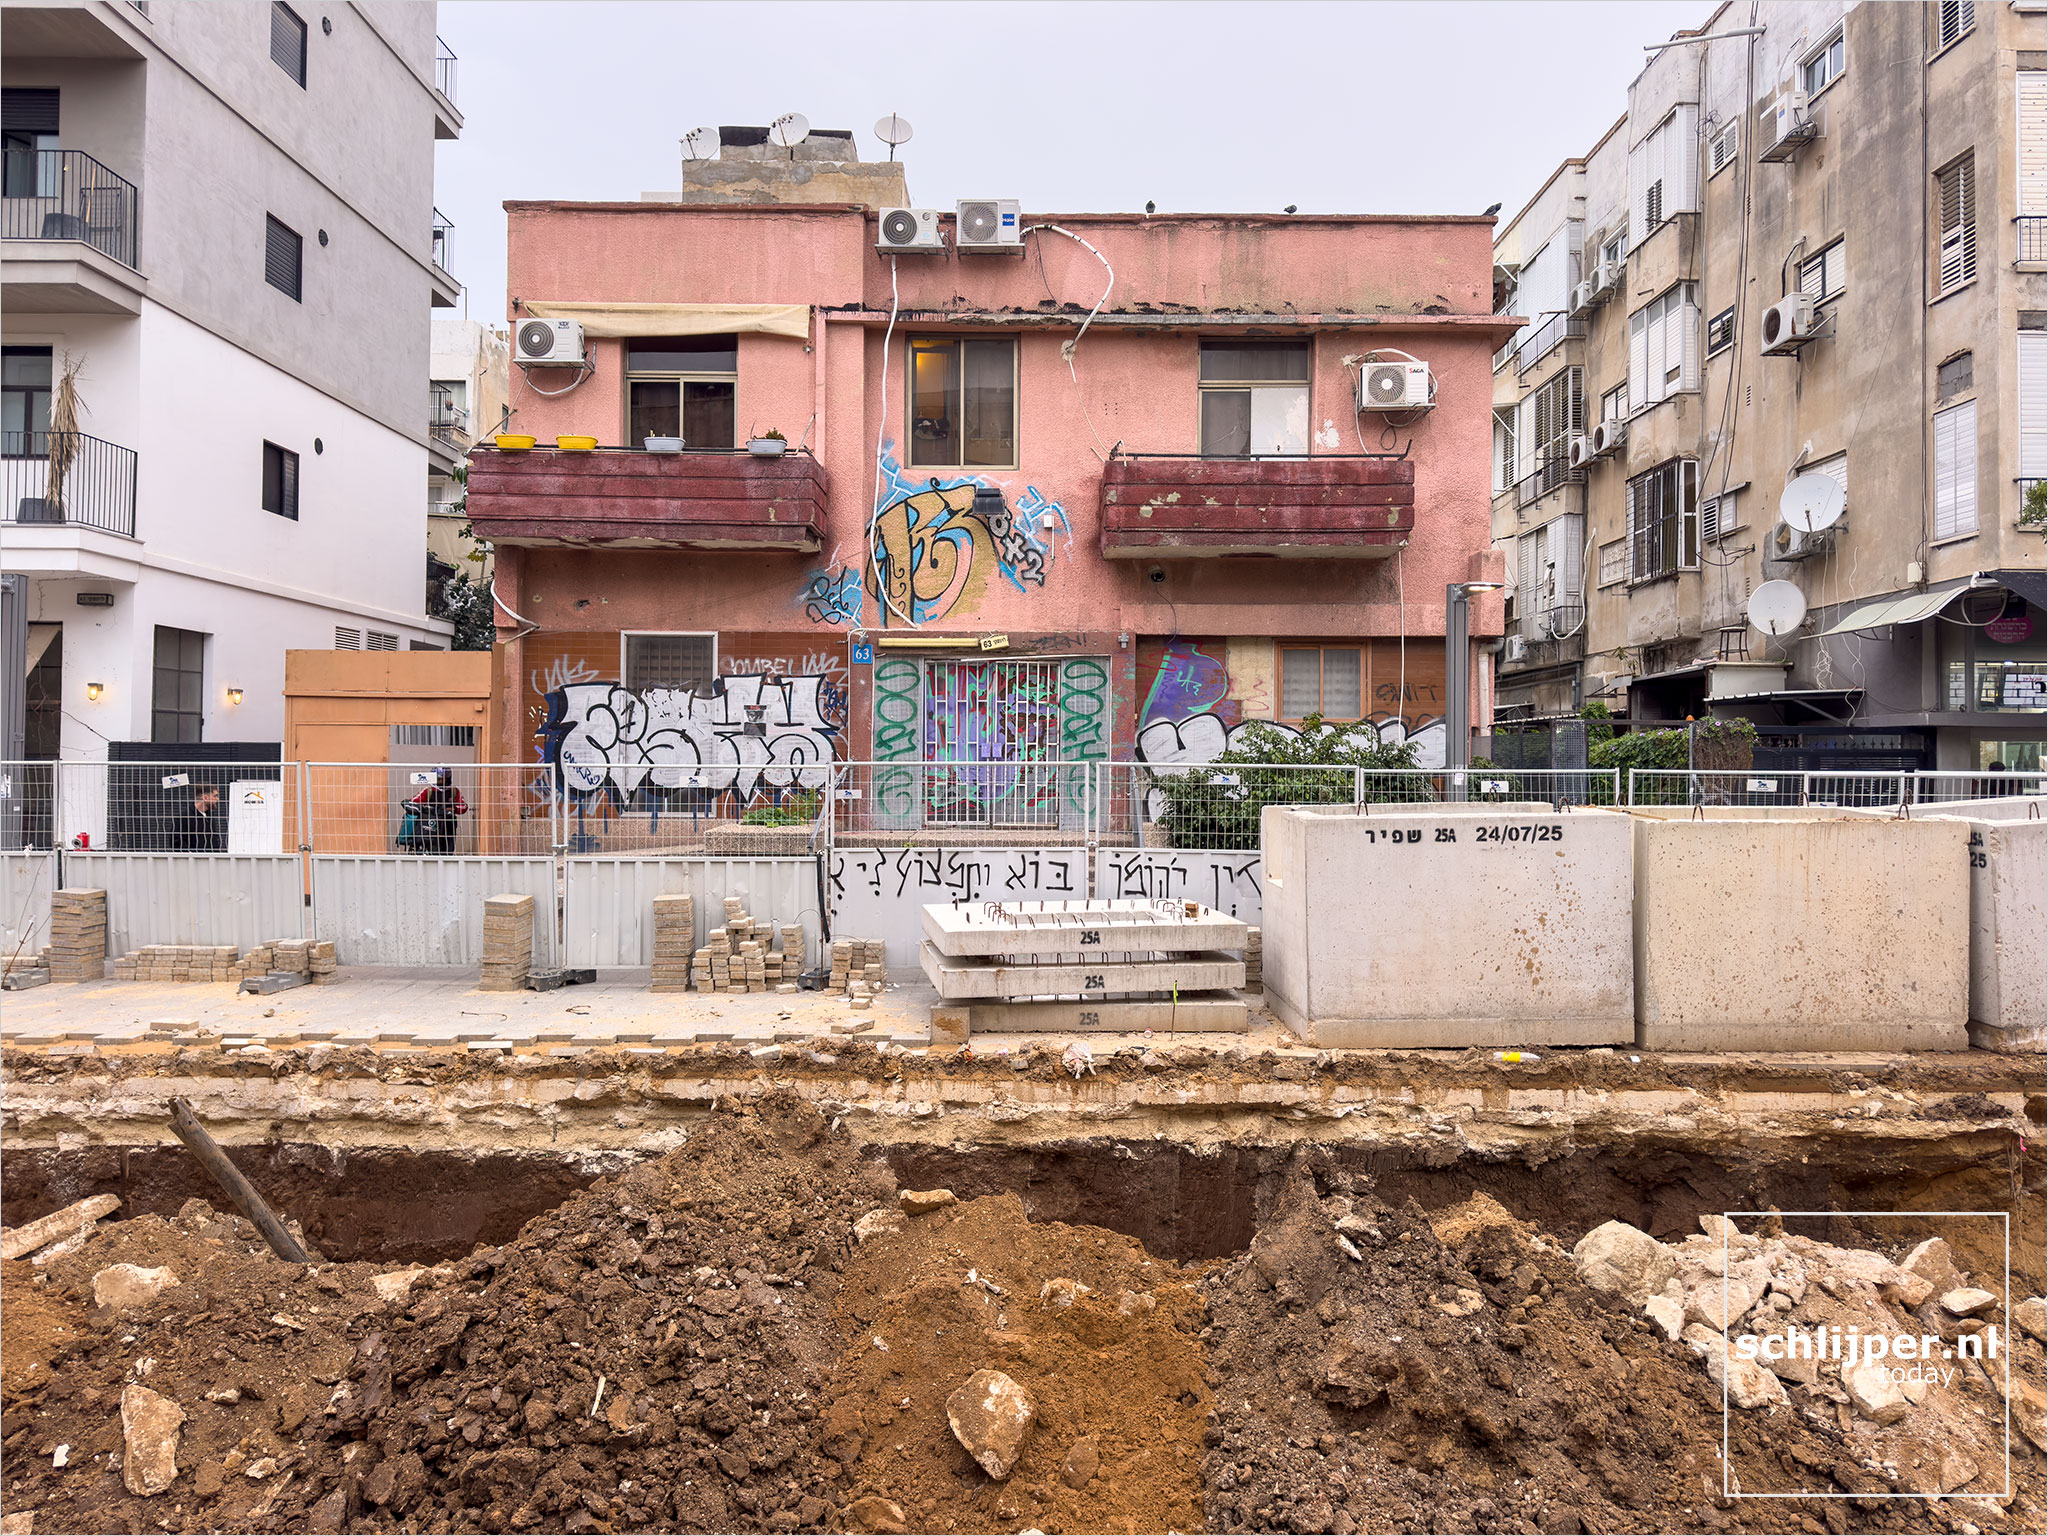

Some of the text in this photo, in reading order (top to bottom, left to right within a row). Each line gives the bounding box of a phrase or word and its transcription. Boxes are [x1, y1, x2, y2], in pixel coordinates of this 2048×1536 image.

[983, 640, 993, 648] 63
[855, 648, 870, 660] 63
[1365, 824, 1563, 845] שפיר 25A 24/07/25
[1080, 931, 1101, 944] 25A
[1085, 975, 1105, 989] 25A
[1079, 1012, 1100, 1026] 25A
